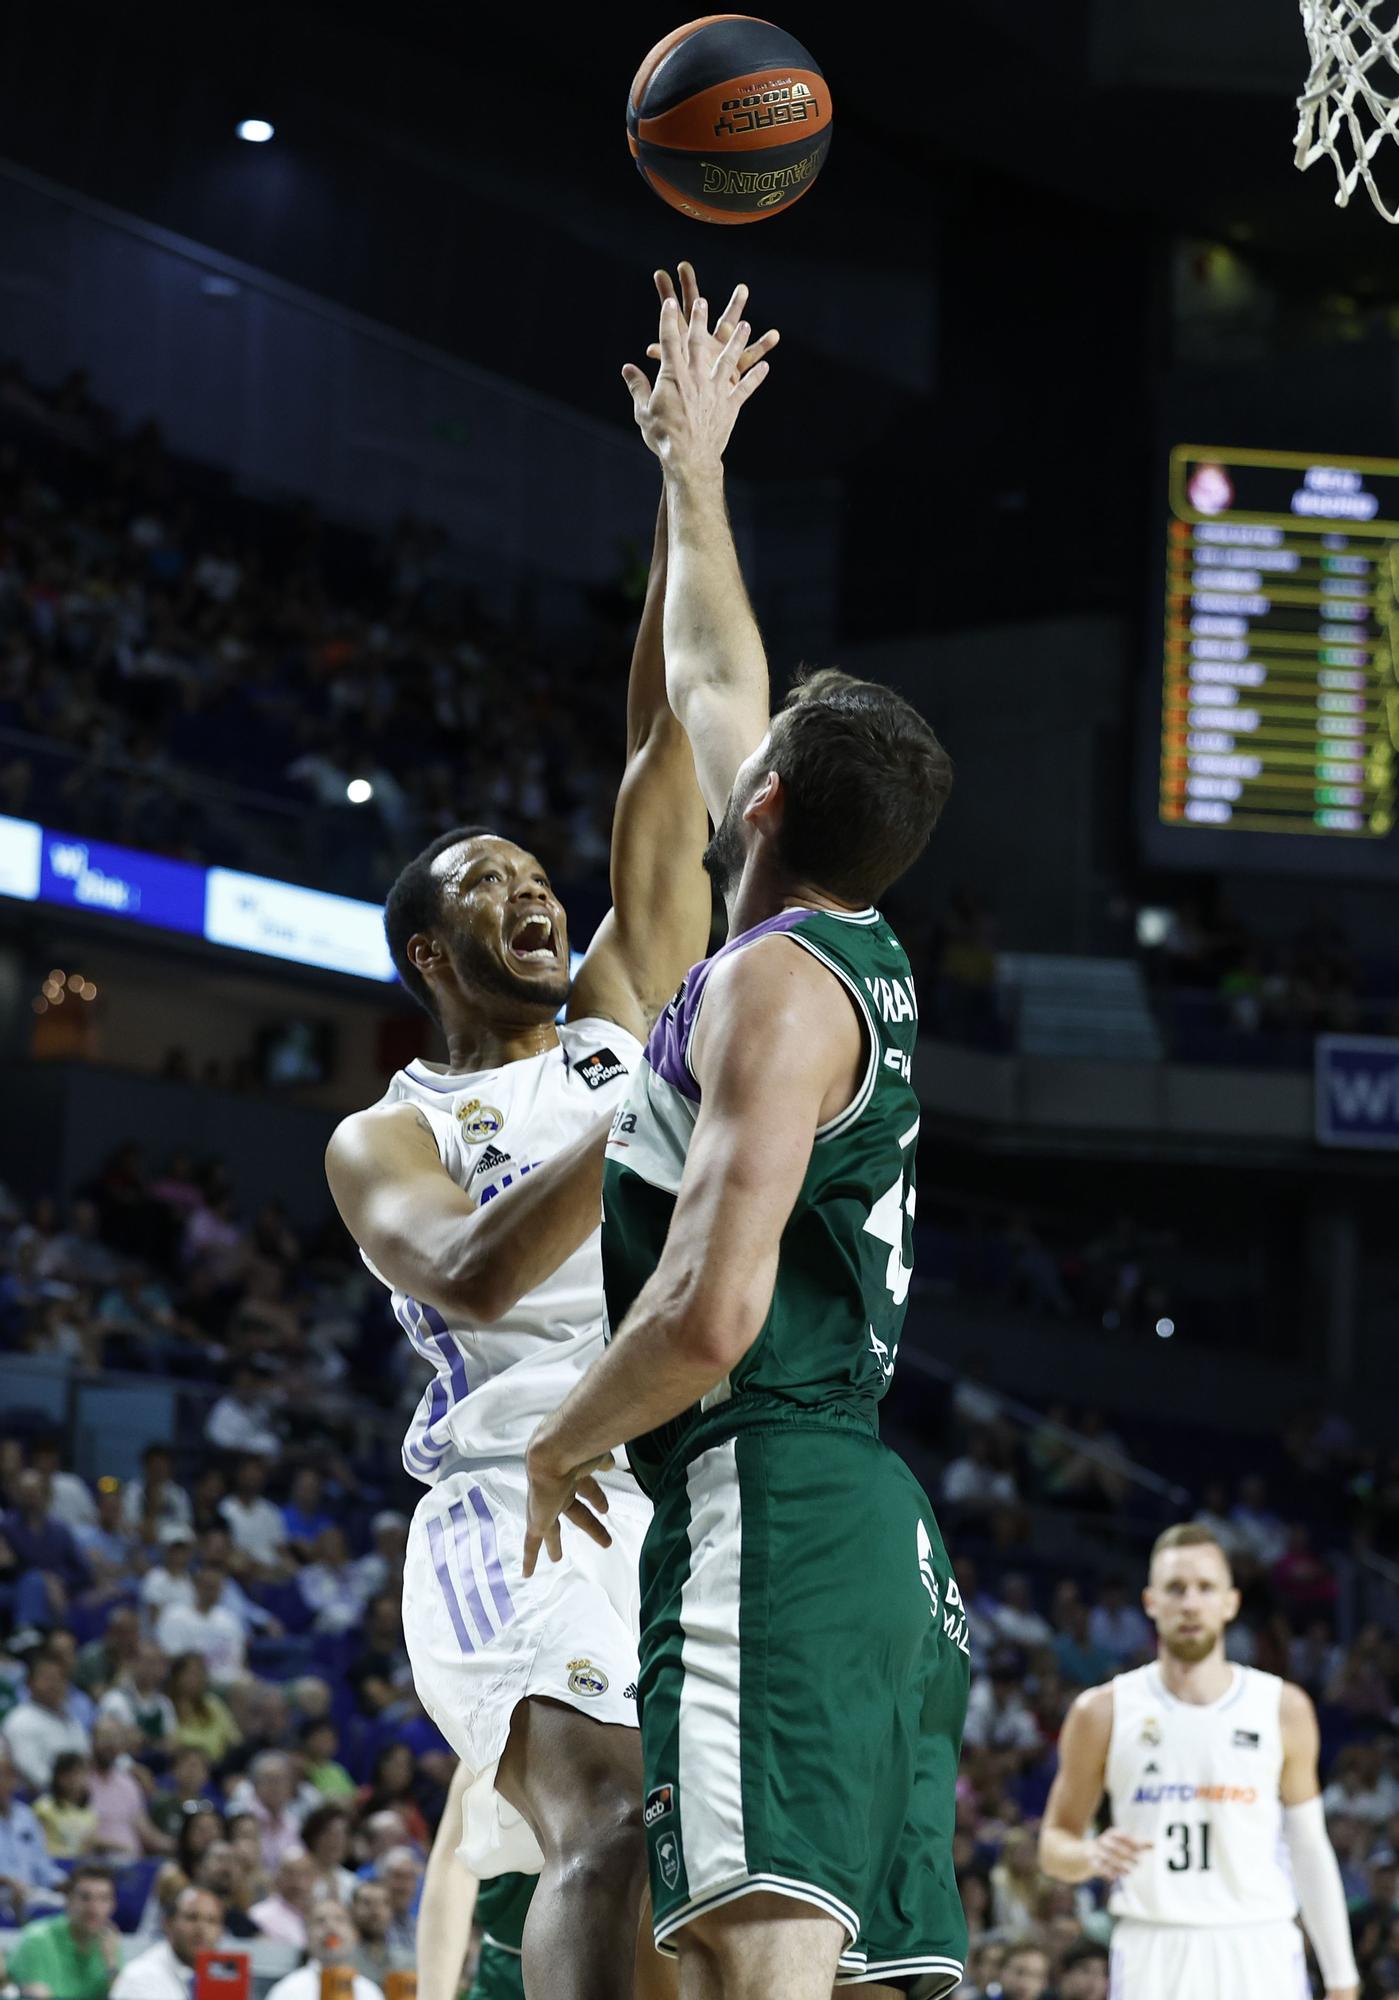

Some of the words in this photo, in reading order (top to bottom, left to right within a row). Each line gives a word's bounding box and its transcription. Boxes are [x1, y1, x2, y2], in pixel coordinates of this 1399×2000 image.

[721, 88, 790, 112] 1000
[713, 98, 819, 137] LEGACY
[703, 142, 826, 194] PALDING
[582, 1062, 604, 1079] liga
[477, 1153, 512, 1174] adidas
[645, 1800, 665, 1821] acb
[1166, 1822, 1211, 1871] 31
